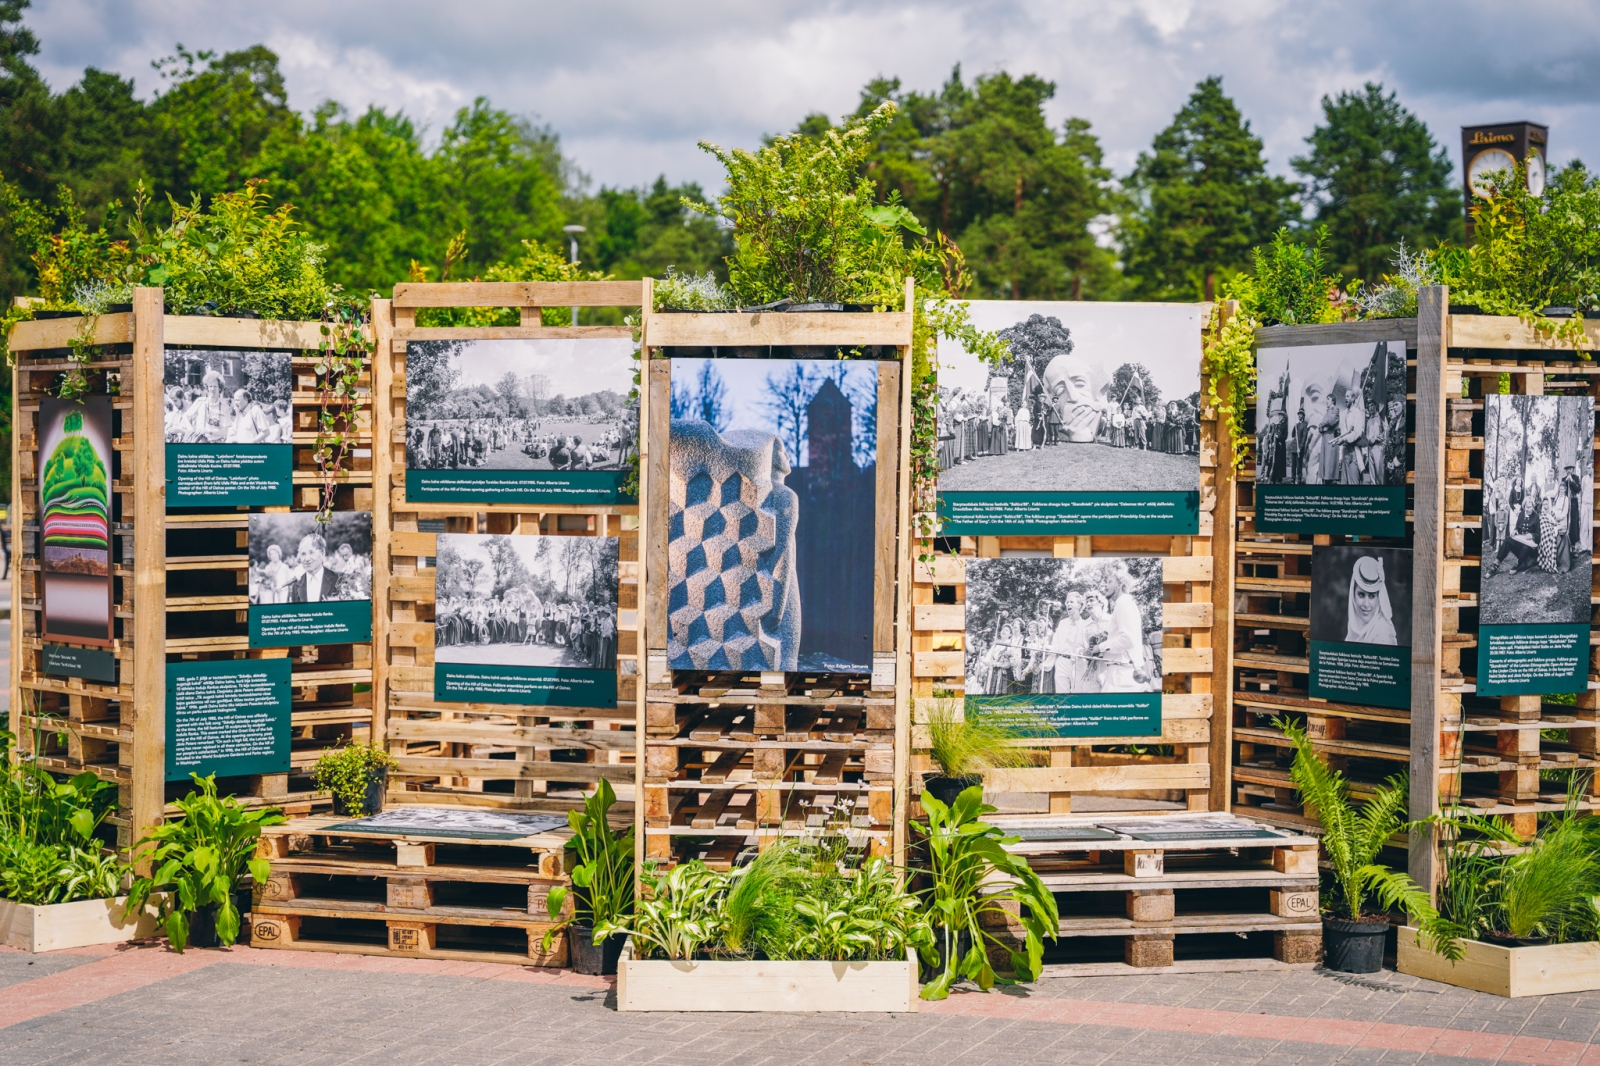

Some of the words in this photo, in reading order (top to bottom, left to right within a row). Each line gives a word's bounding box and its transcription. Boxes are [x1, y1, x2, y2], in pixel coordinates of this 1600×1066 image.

[1469, 131, 1515, 145] Laima
[1292, 898, 1311, 908] EPAL
[258, 926, 277, 937] EPAL
